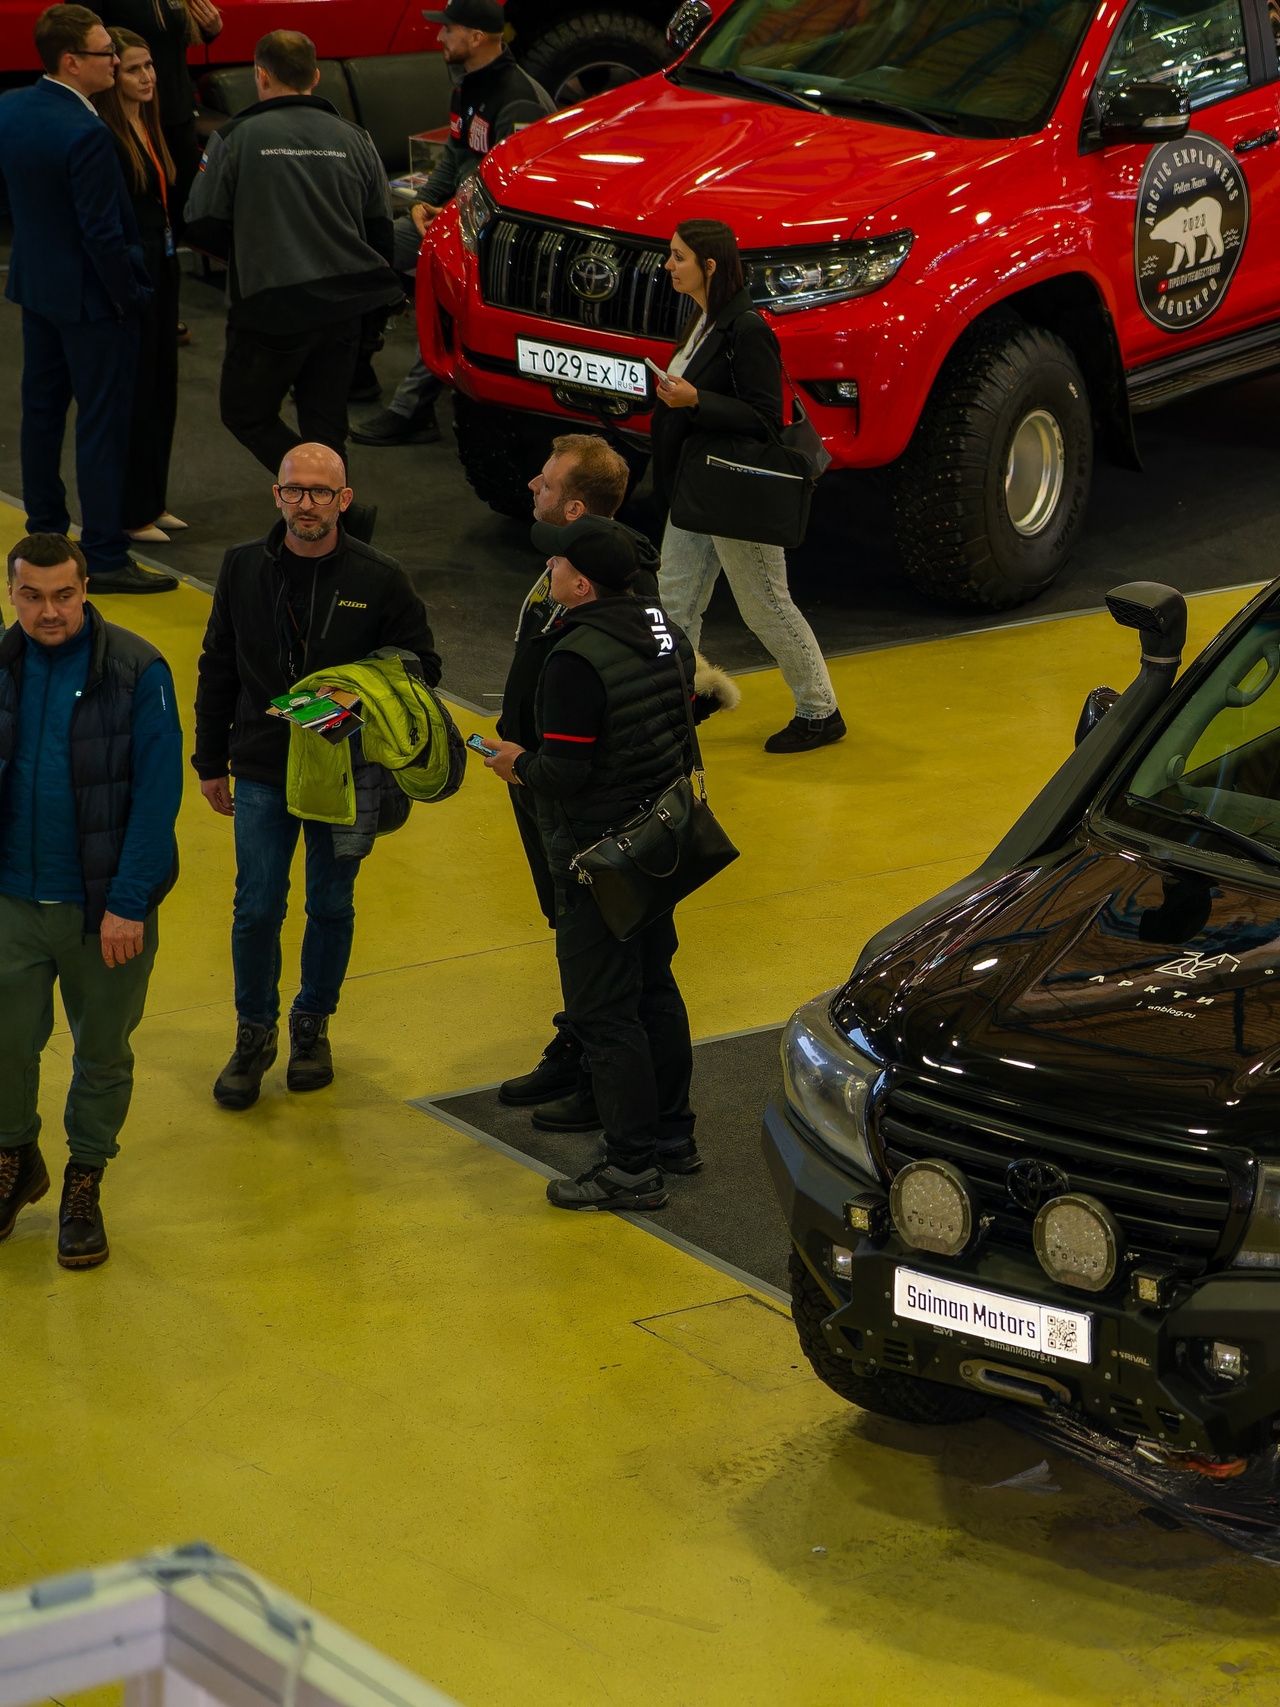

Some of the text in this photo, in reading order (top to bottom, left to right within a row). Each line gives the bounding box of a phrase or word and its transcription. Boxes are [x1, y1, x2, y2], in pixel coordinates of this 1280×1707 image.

[1144, 148, 1239, 227] ARCTIC EXPLORERS
[1182, 213, 1207, 233] 2023
[618, 362, 639, 384] 76
[617, 380, 633, 391] RUS
[338, 599, 368, 609] Klim
[907, 1215, 954, 1232] SOLIS
[907, 1285, 1036, 1339] Saiman Motors
[983, 1337, 1057, 1365] SaimanMotors.ru
